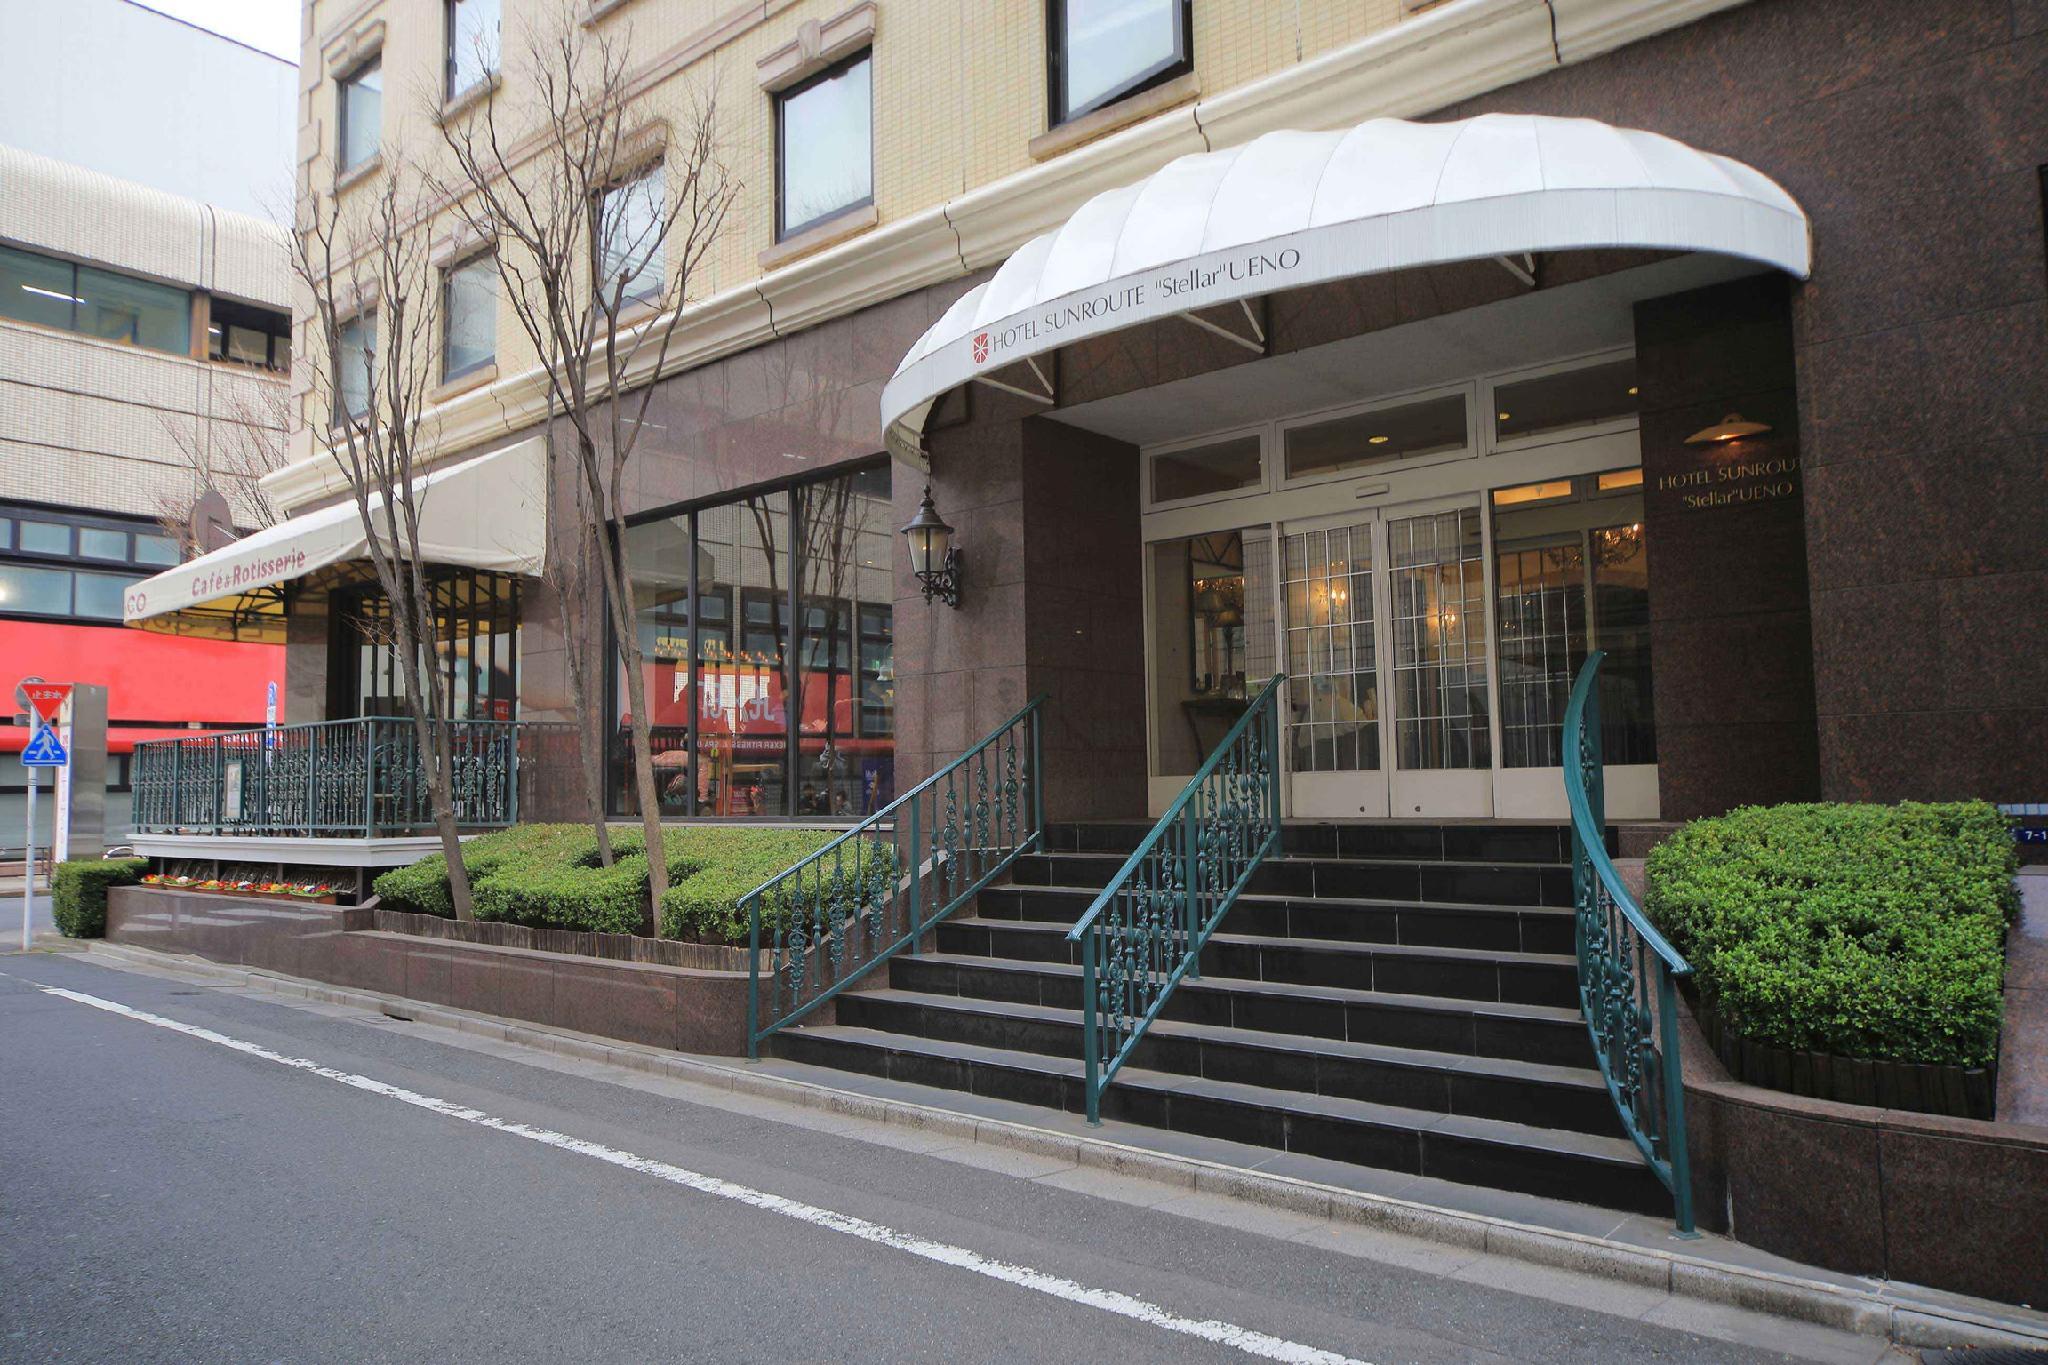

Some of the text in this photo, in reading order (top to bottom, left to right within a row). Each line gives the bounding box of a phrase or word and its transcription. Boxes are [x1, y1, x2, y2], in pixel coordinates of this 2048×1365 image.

[993, 320, 1039, 352] HOTEL
[1045, 284, 1145, 333] SUNROUTE
[1659, 458, 1800, 491] HOTEL SUNROU
